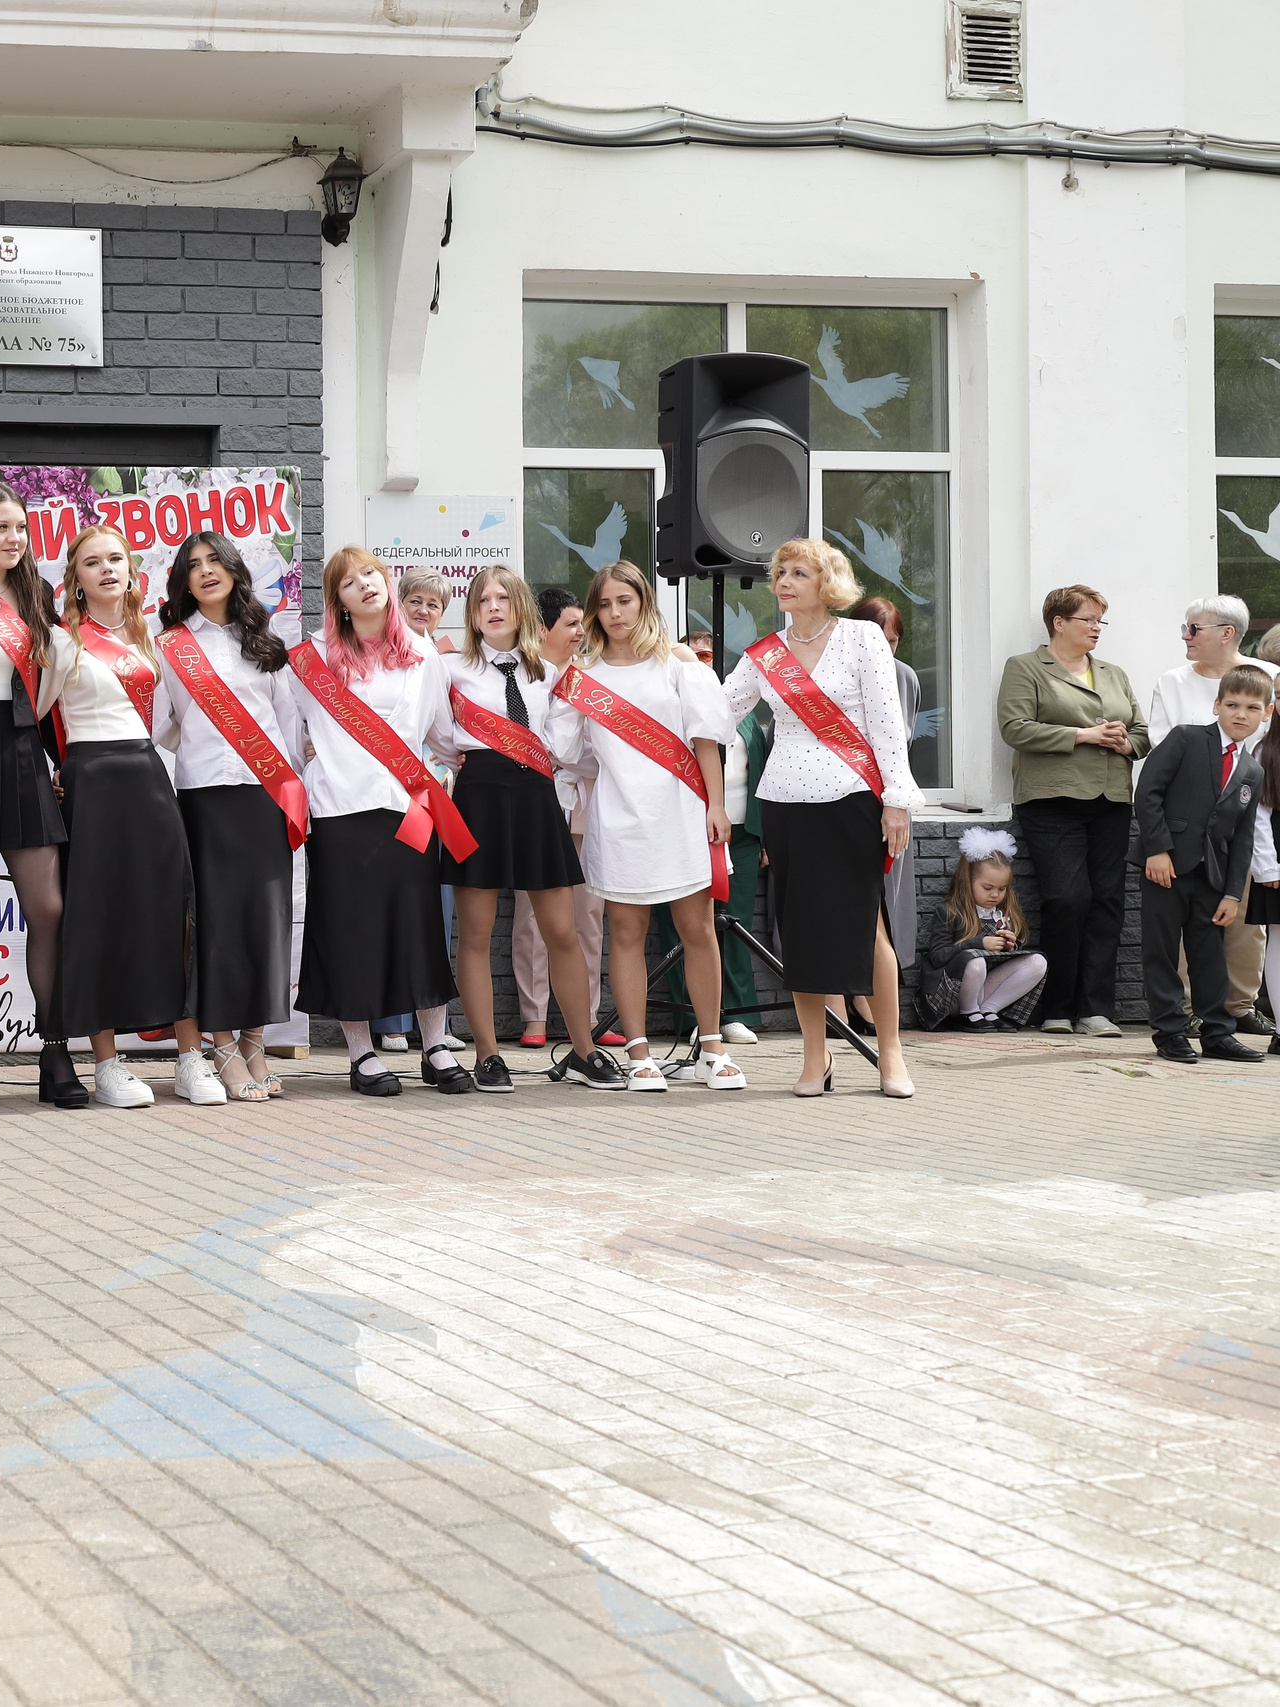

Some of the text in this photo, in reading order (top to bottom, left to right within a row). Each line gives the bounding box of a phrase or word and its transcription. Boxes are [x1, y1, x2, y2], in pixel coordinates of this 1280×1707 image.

[16, 277, 62, 285] образования
[19, 268, 53, 276] Нижнего
[55, 270, 94, 278] Новгорода
[22, 296, 84, 306] БЮДЖЕТНОЕ
[28, 336, 52, 352] №
[58, 337, 86, 352] 75»
[97, 482, 291, 551] ЗВОНОК
[372, 545, 510, 559] ФЕДЕРАЛЬНЫЙ ПРОЕКТ
[778, 664, 830, 721] Классный
[174, 644, 243, 734] Выпускница
[237, 729, 285, 778] 2025
[313, 673, 391, 754] Выпускница
[583, 688, 675, 759] Выпускница
[672, 751, 702, 787] 202
